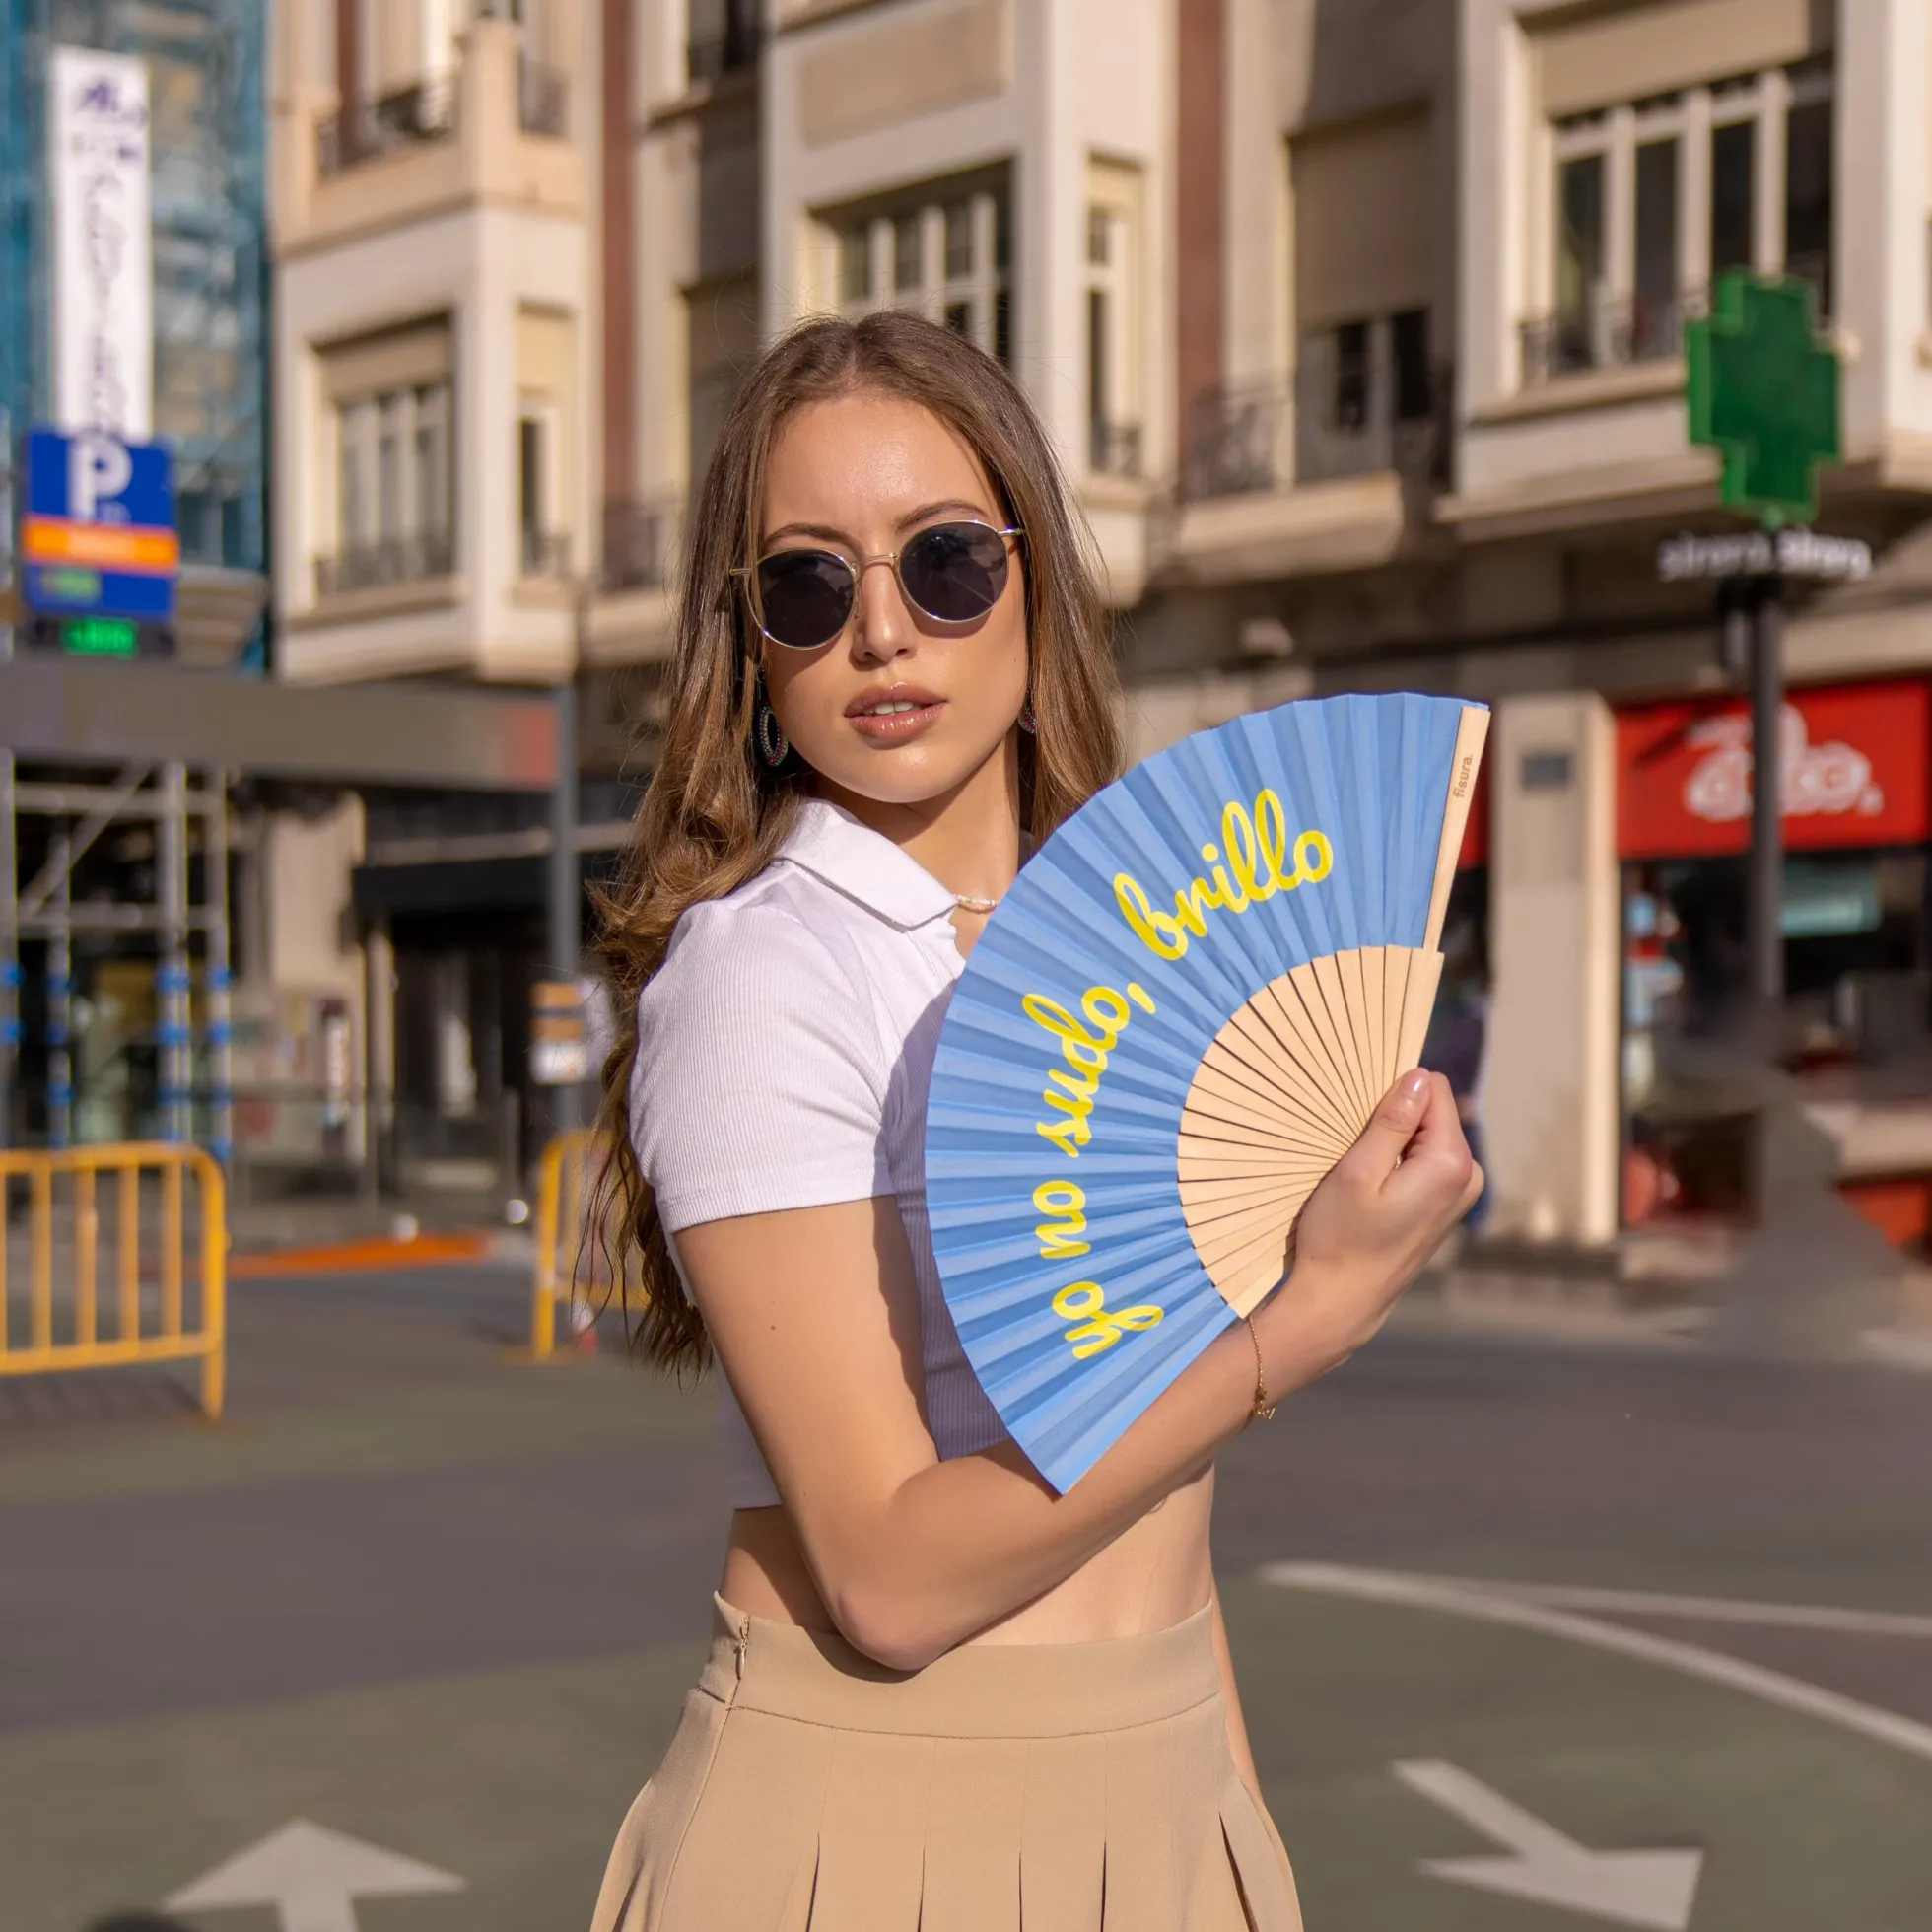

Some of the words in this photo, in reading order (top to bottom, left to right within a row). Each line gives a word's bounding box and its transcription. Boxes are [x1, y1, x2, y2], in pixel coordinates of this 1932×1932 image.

[67, 436, 134, 524] P
[1114, 788, 1334, 961] brillo
[1021, 982, 1156, 1157] sudo,
[1031, 1180, 1091, 1259] no
[1052, 1281, 1164, 1359] yo
